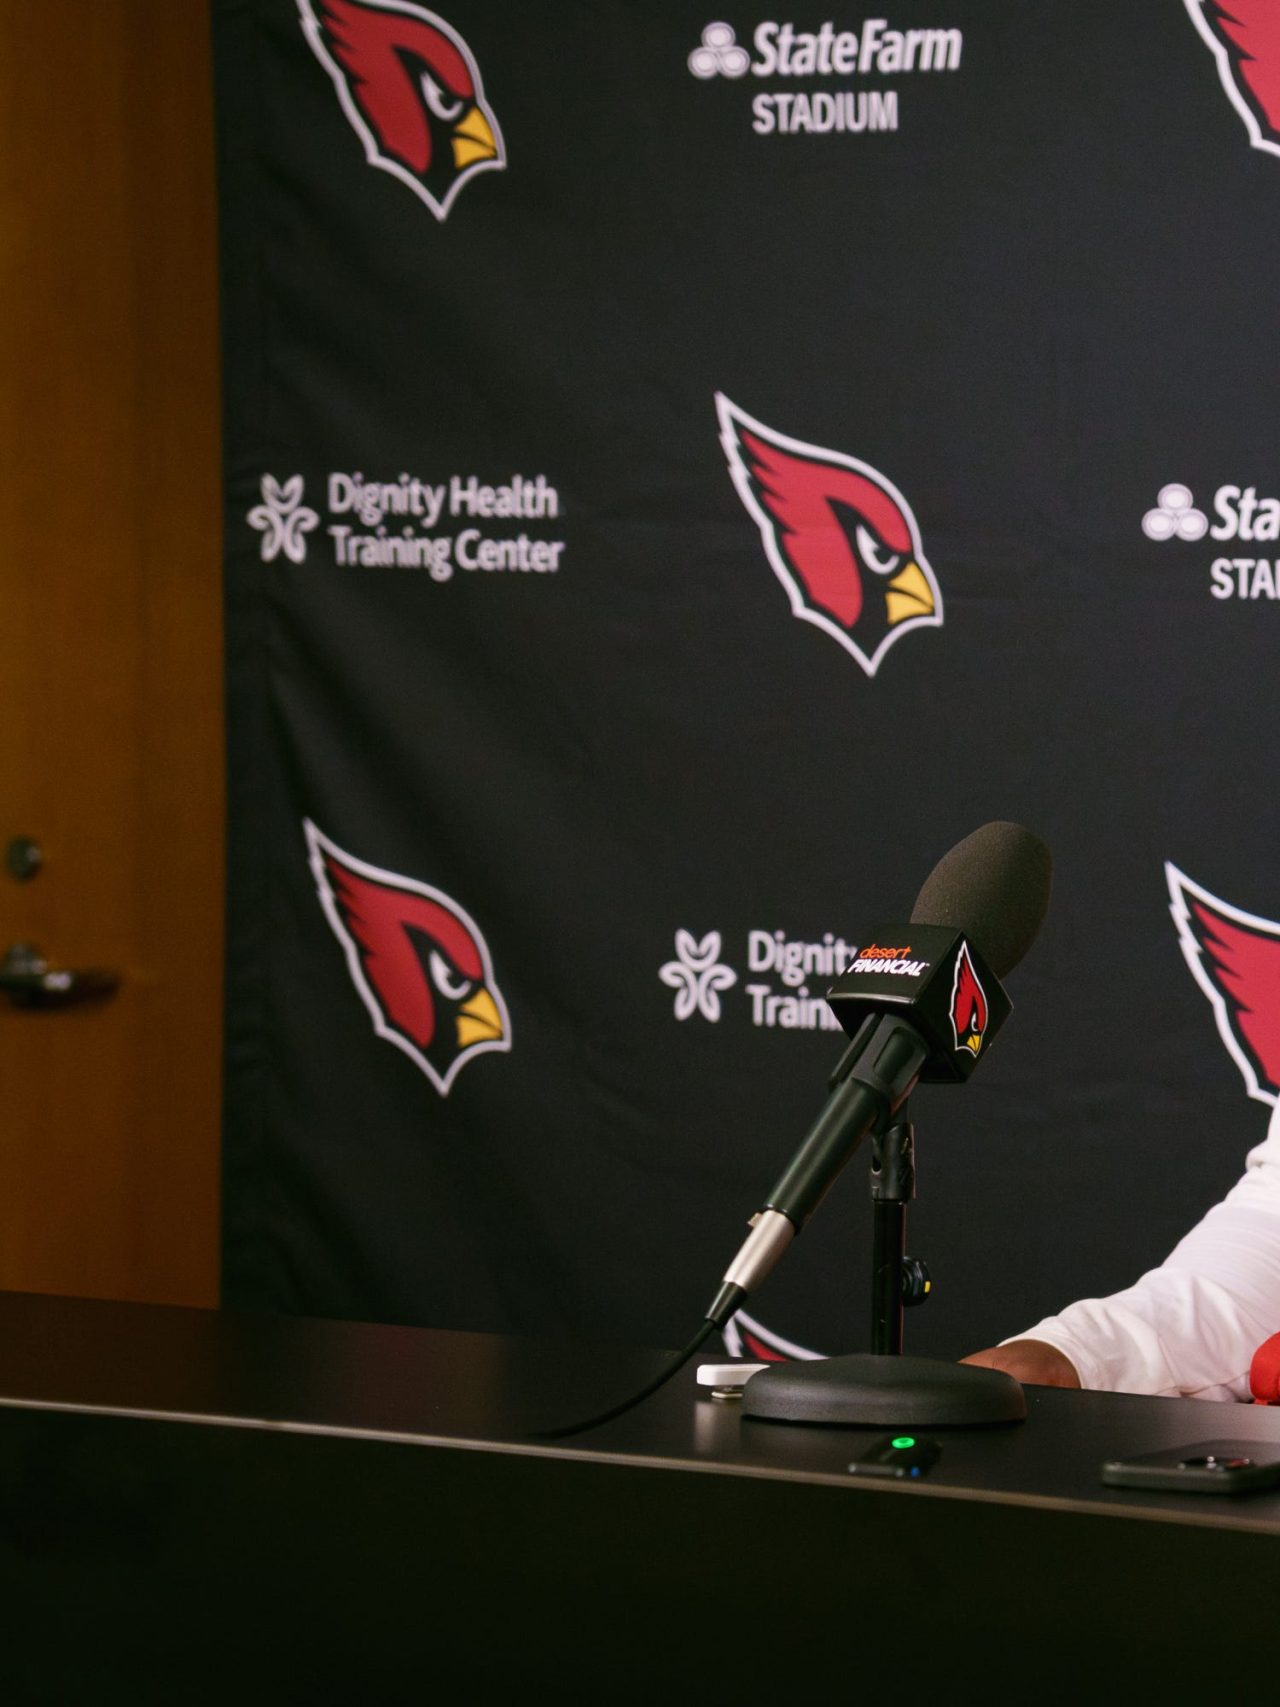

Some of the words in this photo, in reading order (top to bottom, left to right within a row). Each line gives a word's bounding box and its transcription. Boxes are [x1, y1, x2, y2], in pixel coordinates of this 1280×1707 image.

[752, 90, 898, 134] STADIUM
[328, 472, 446, 527] Dignity
[449, 474, 559, 519] Health
[327, 524, 453, 582] Training
[455, 528, 566, 573] Center
[748, 930, 857, 985] Dignit
[848, 959, 926, 976] FINANCIAL
[860, 944, 911, 959] desert
